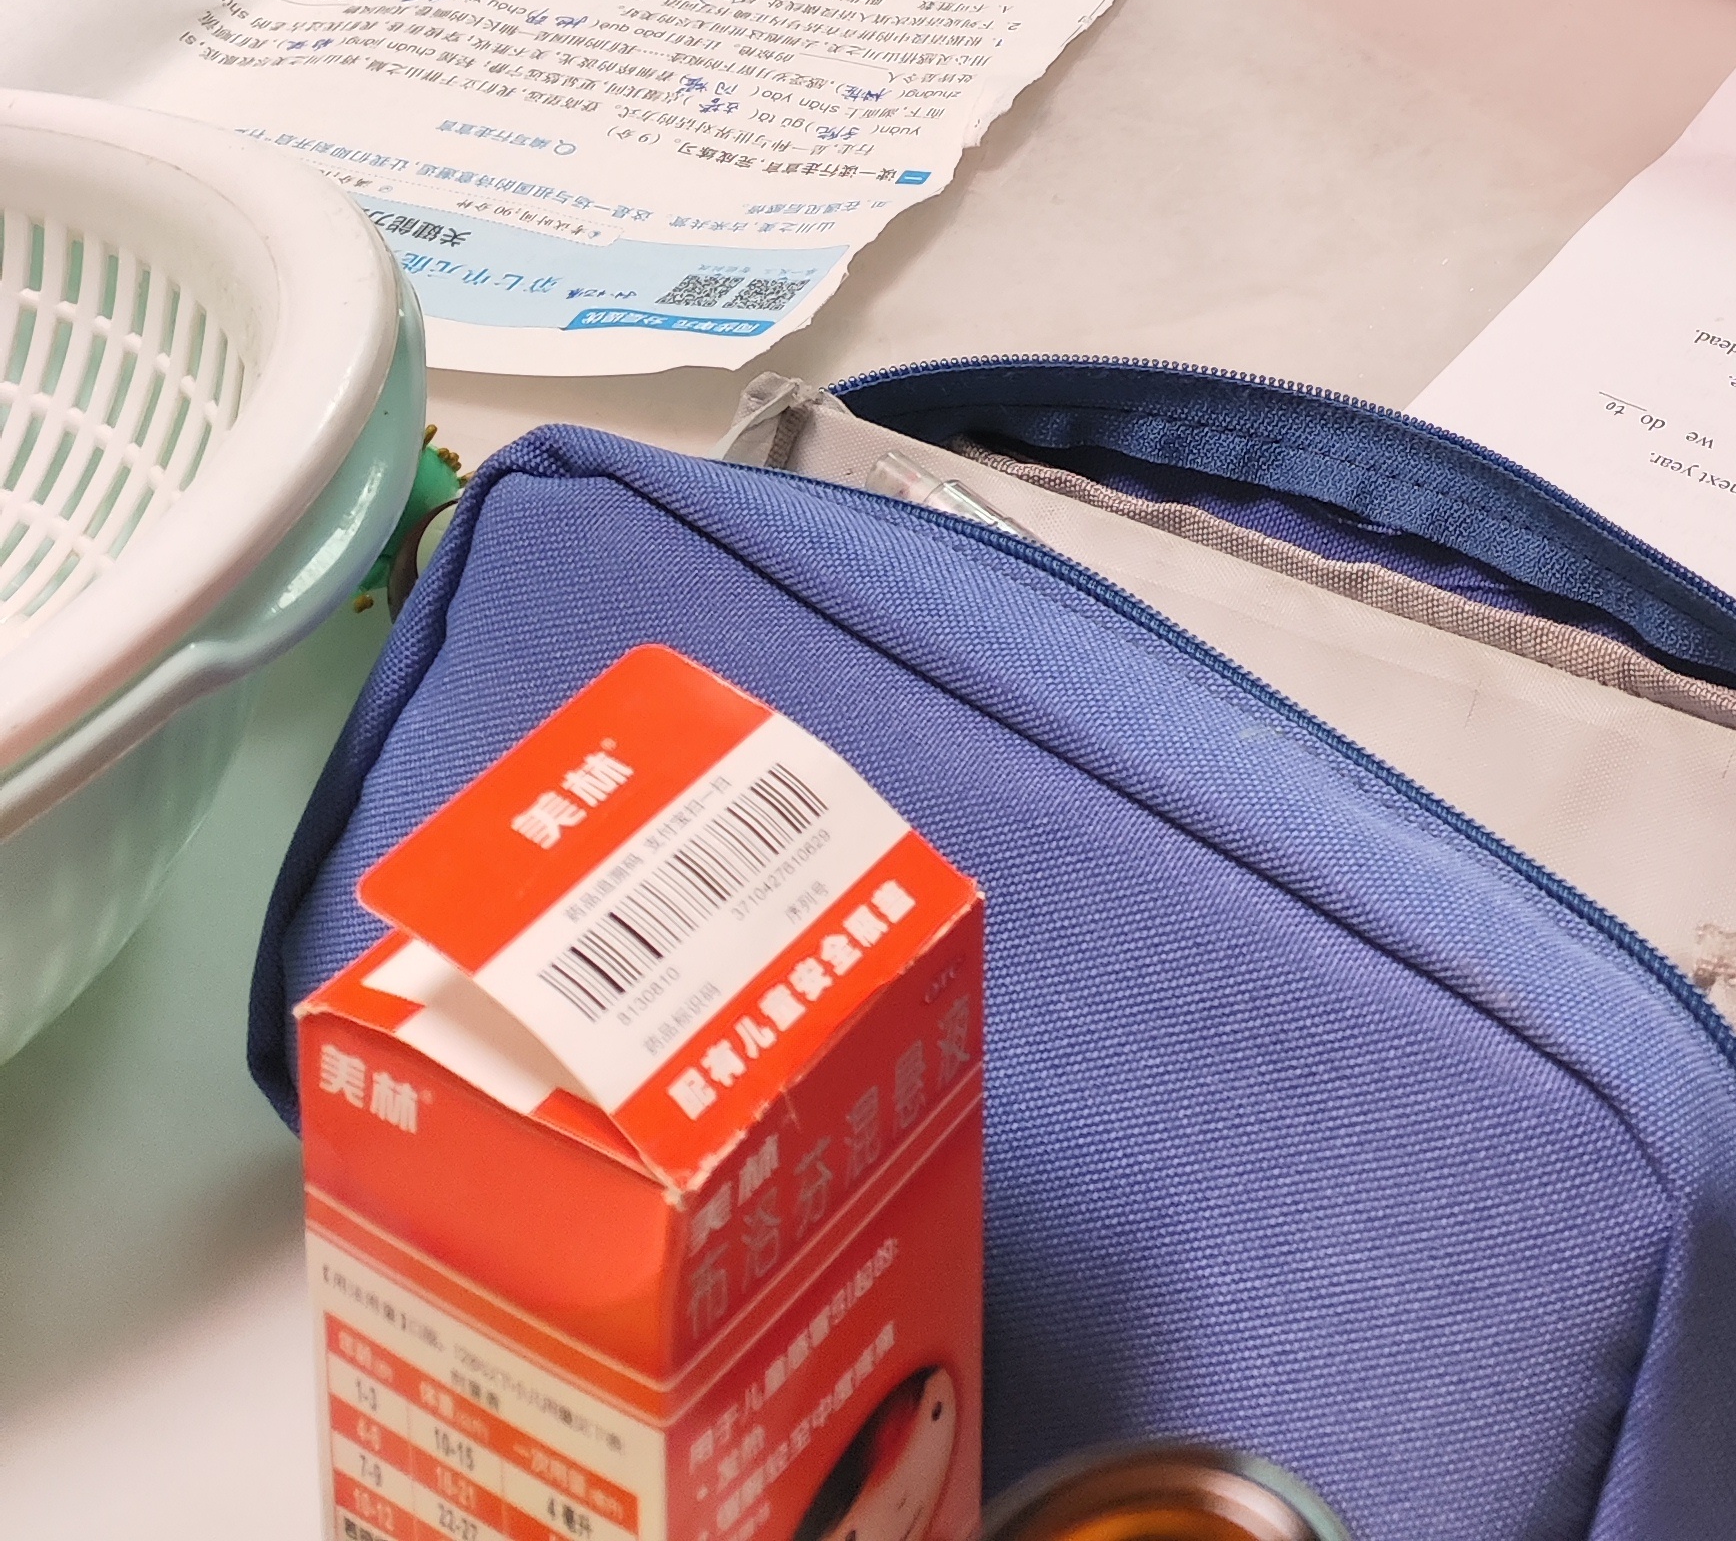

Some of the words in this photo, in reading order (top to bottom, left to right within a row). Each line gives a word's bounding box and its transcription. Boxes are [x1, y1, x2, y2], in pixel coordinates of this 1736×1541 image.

[395, 250, 563, 294] 第七单元能
[1606, 402, 1626, 417] to
[1640, 415, 1666, 432] do
[1686, 432, 1714, 450] we
[1650, 452, 1700, 478] year.
[511, 751, 634, 849] 美林
[319, 1042, 419, 1135] 美林
[688, 1132, 779, 1257] 美林
